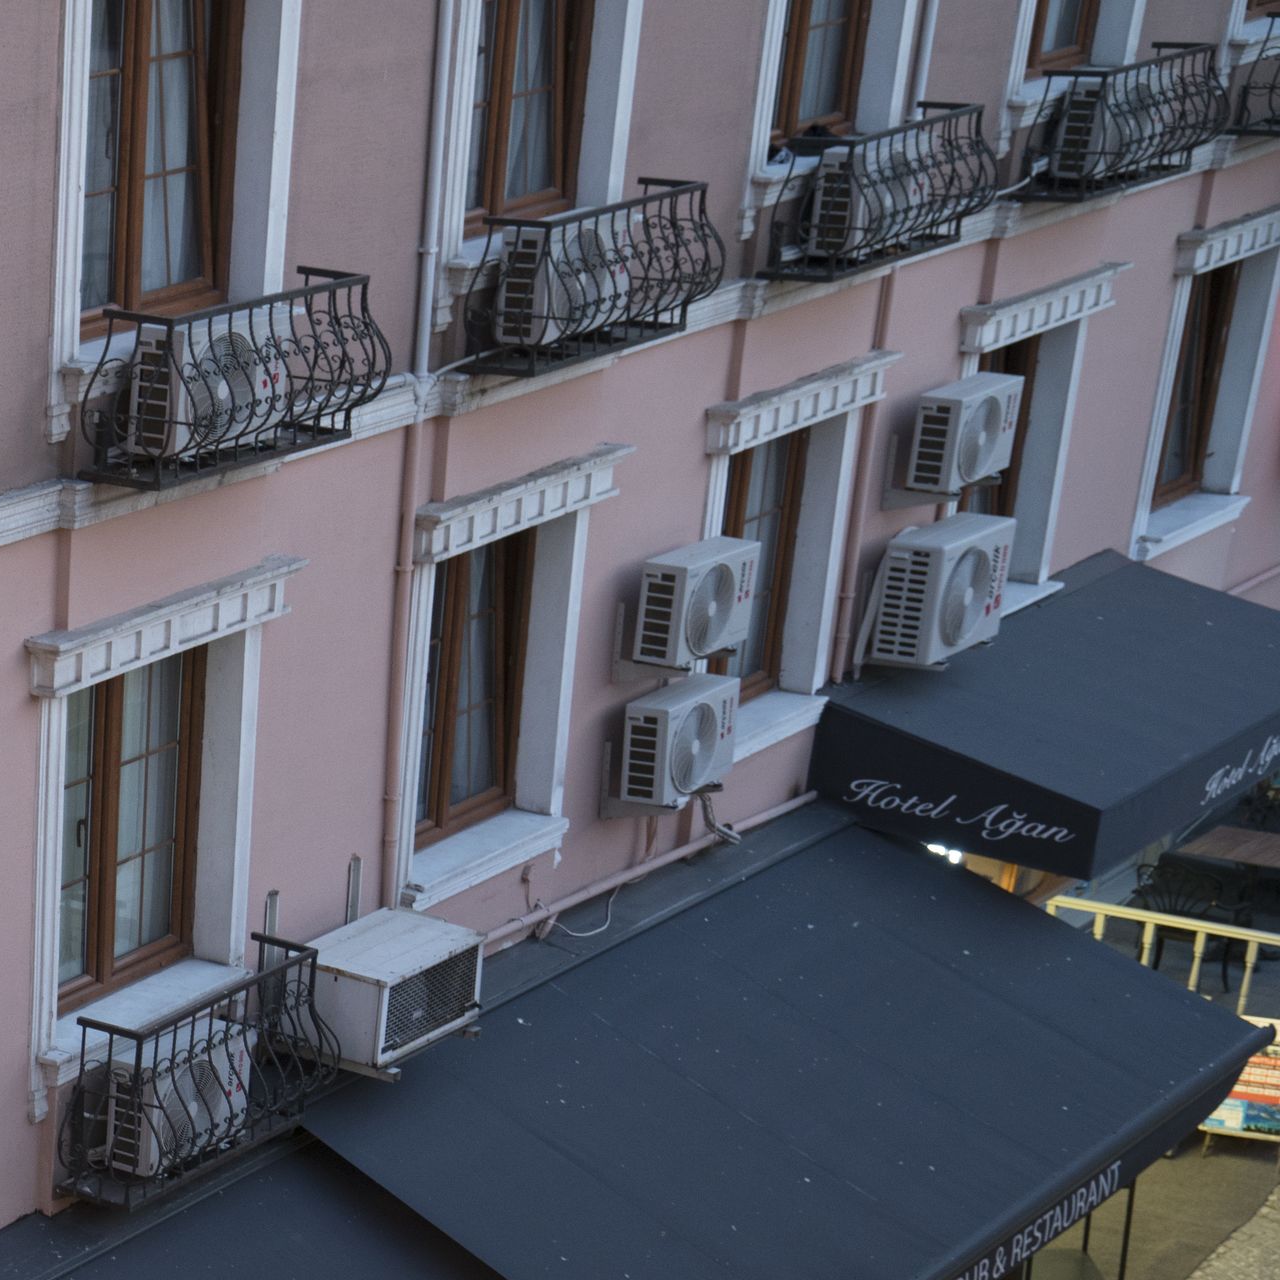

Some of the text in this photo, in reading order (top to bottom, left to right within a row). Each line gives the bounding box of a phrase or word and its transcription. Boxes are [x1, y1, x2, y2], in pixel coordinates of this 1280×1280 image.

[1200, 749, 1253, 805] Hotel
[842, 779, 1077, 842] Hotel Ağan
[992, 1246, 1007, 1279] &
[1010, 1160, 1122, 1267] RESTAURANT
